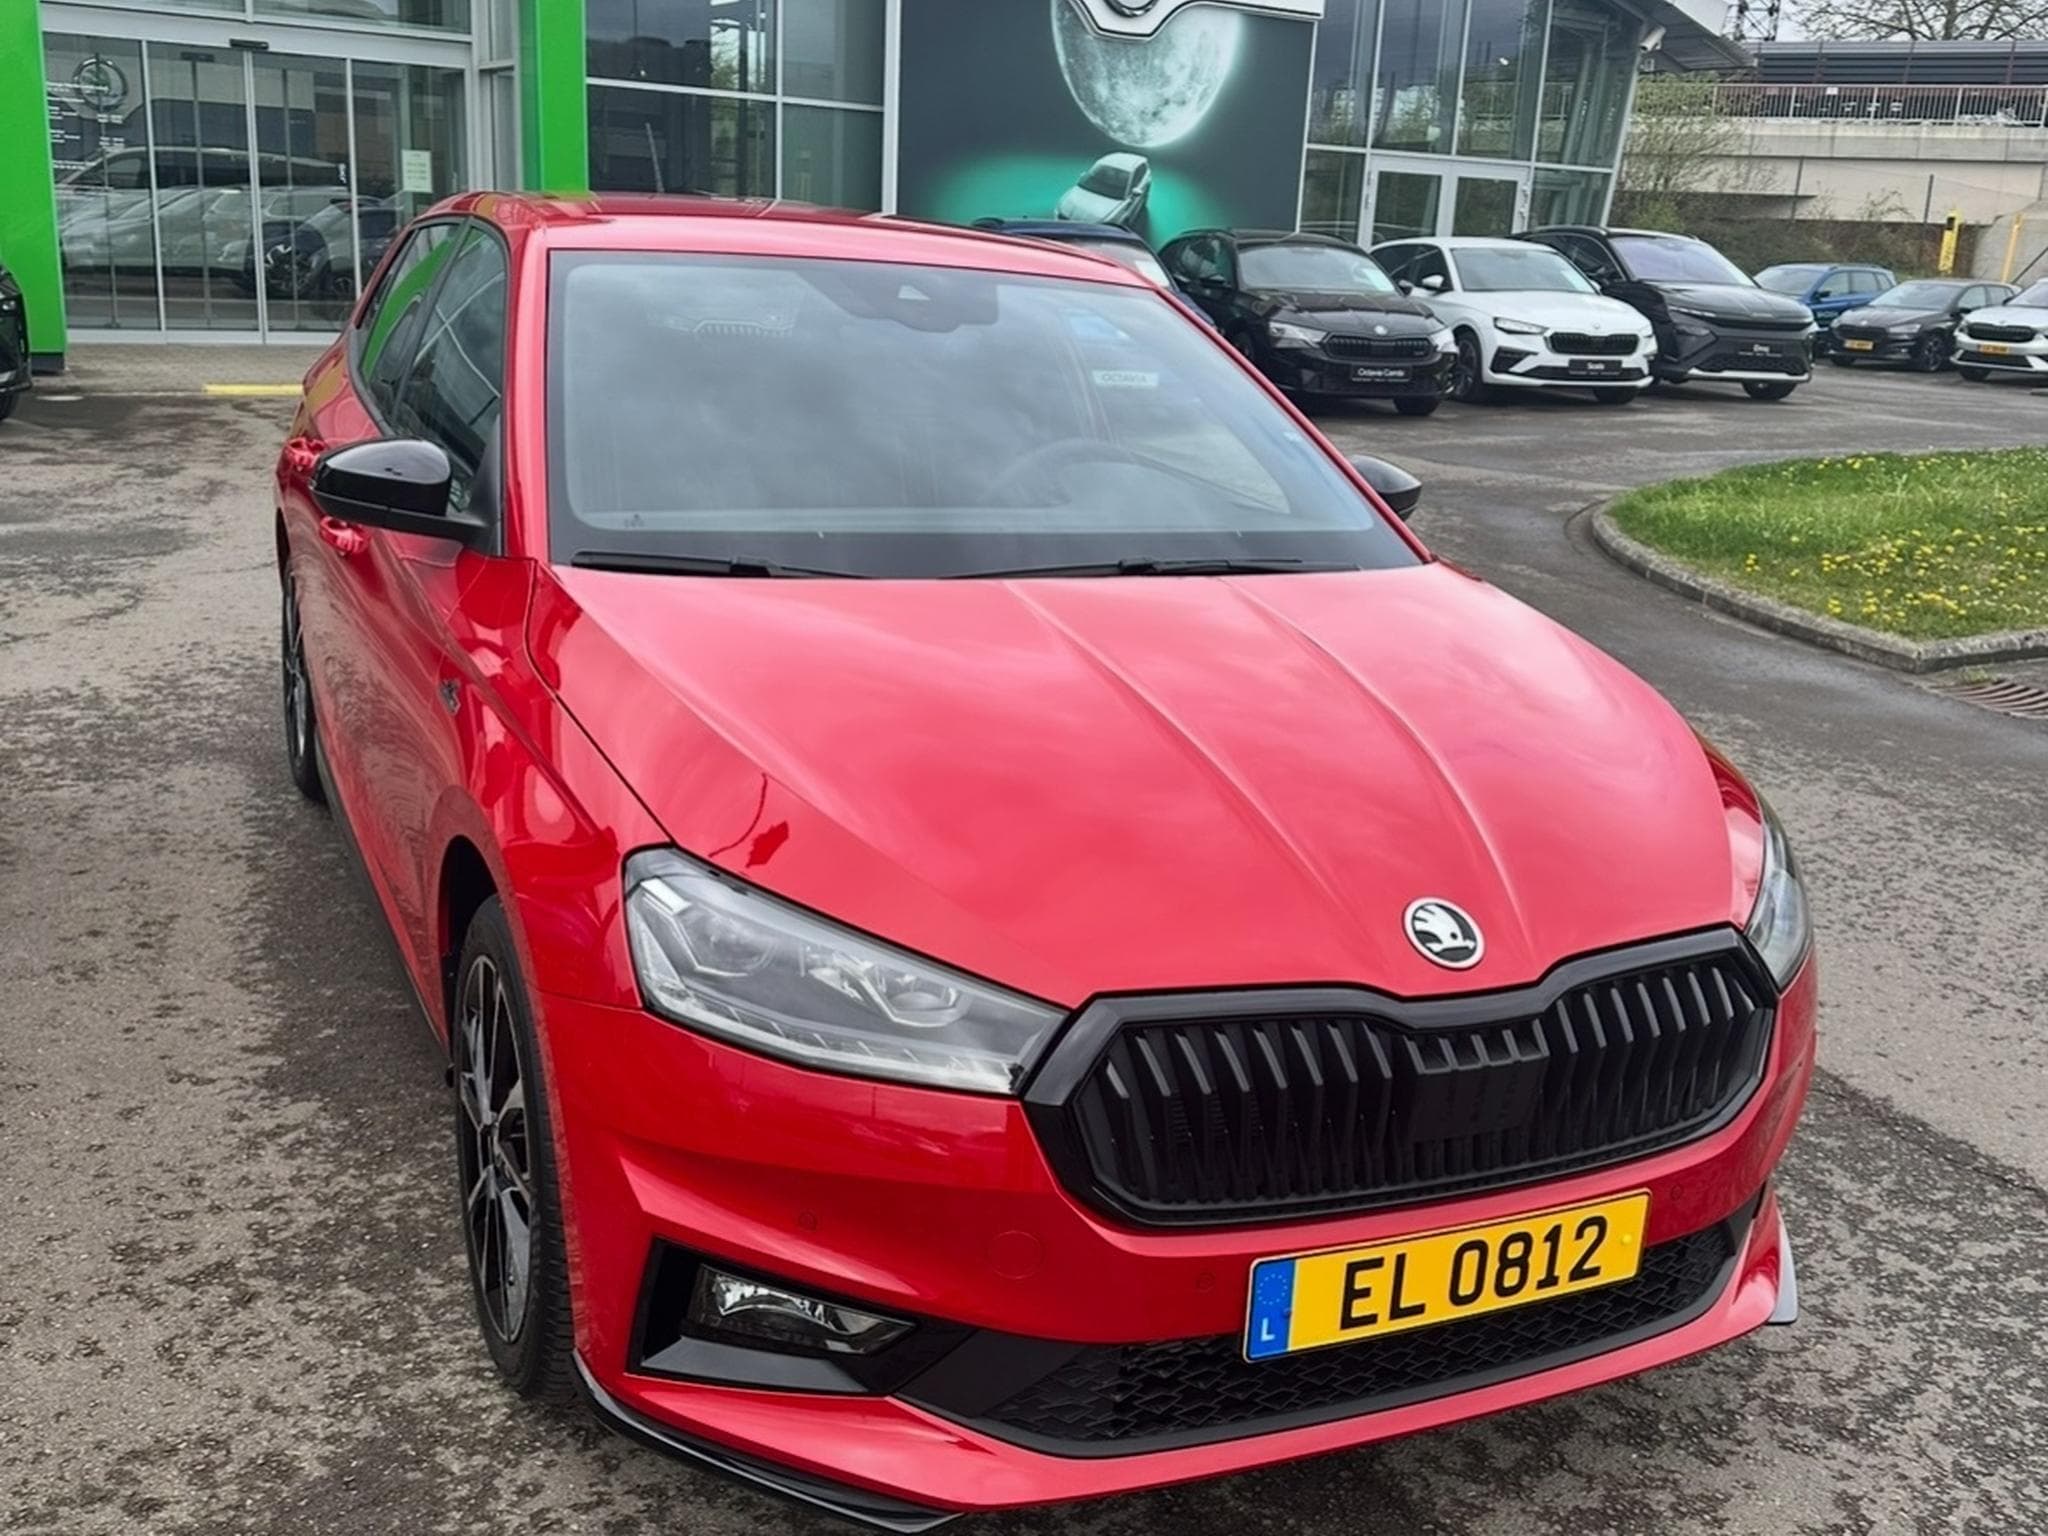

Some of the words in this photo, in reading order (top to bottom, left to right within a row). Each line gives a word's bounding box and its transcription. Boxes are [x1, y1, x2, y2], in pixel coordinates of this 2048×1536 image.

[1339, 1252, 1427, 1331] EL
[1447, 1214, 1608, 1307] 0812
[1260, 1318, 1276, 1342] L
